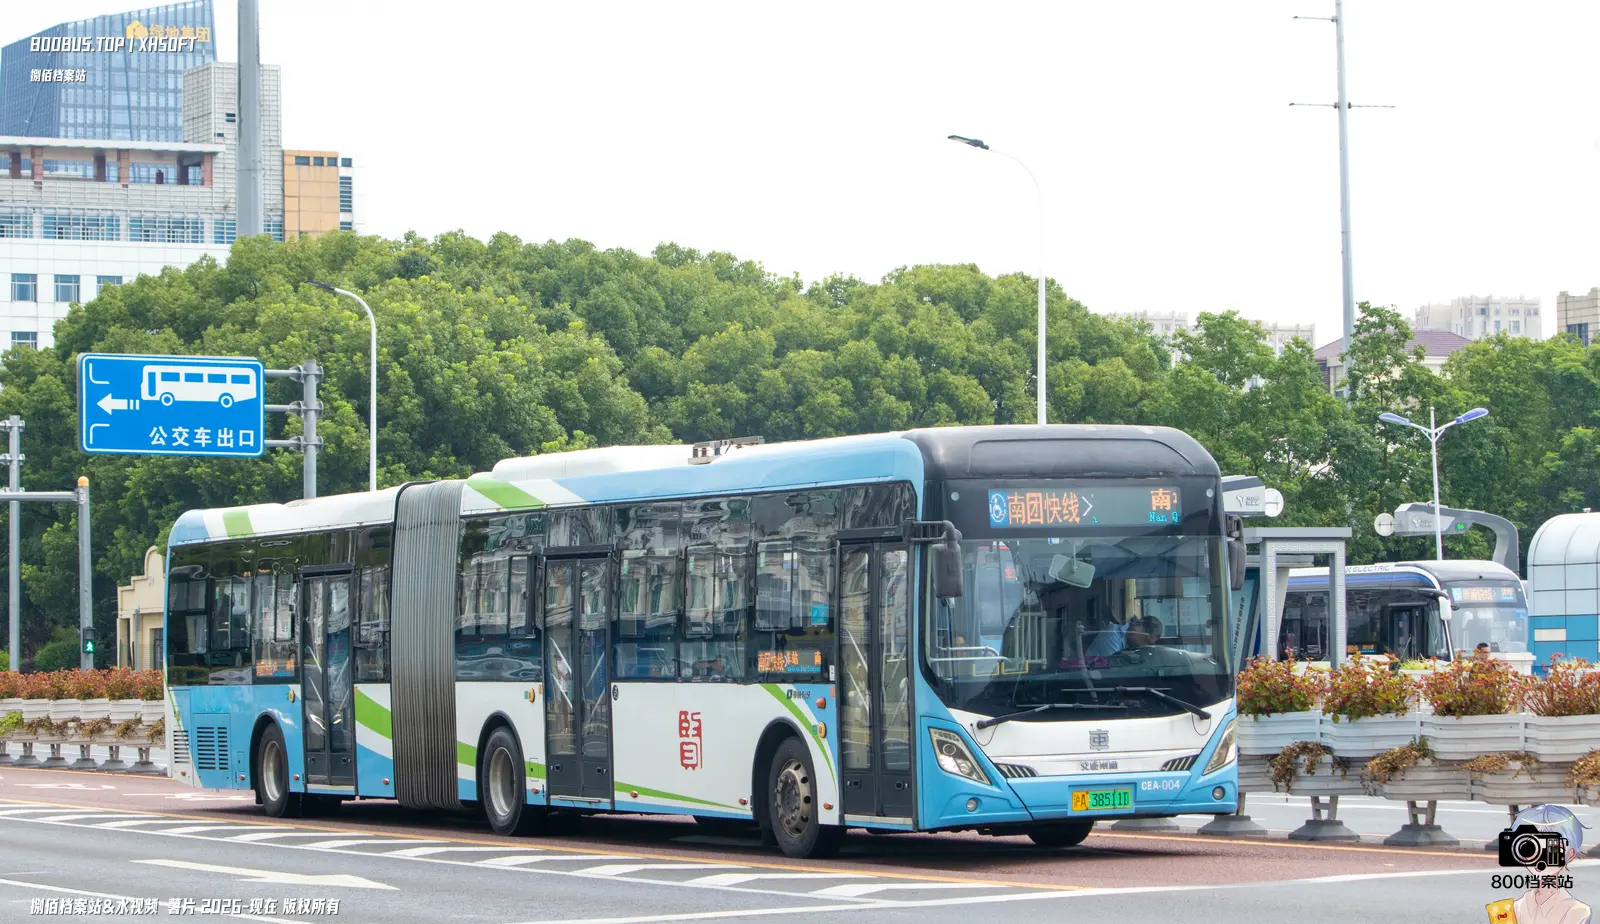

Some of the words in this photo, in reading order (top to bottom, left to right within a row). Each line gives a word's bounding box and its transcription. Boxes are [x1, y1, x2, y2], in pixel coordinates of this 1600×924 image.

[149, 426, 255, 448] 公交车出口
[1007, 492, 1081, 525] 南团快线
[1141, 779, 1180, 791] CEA-004
